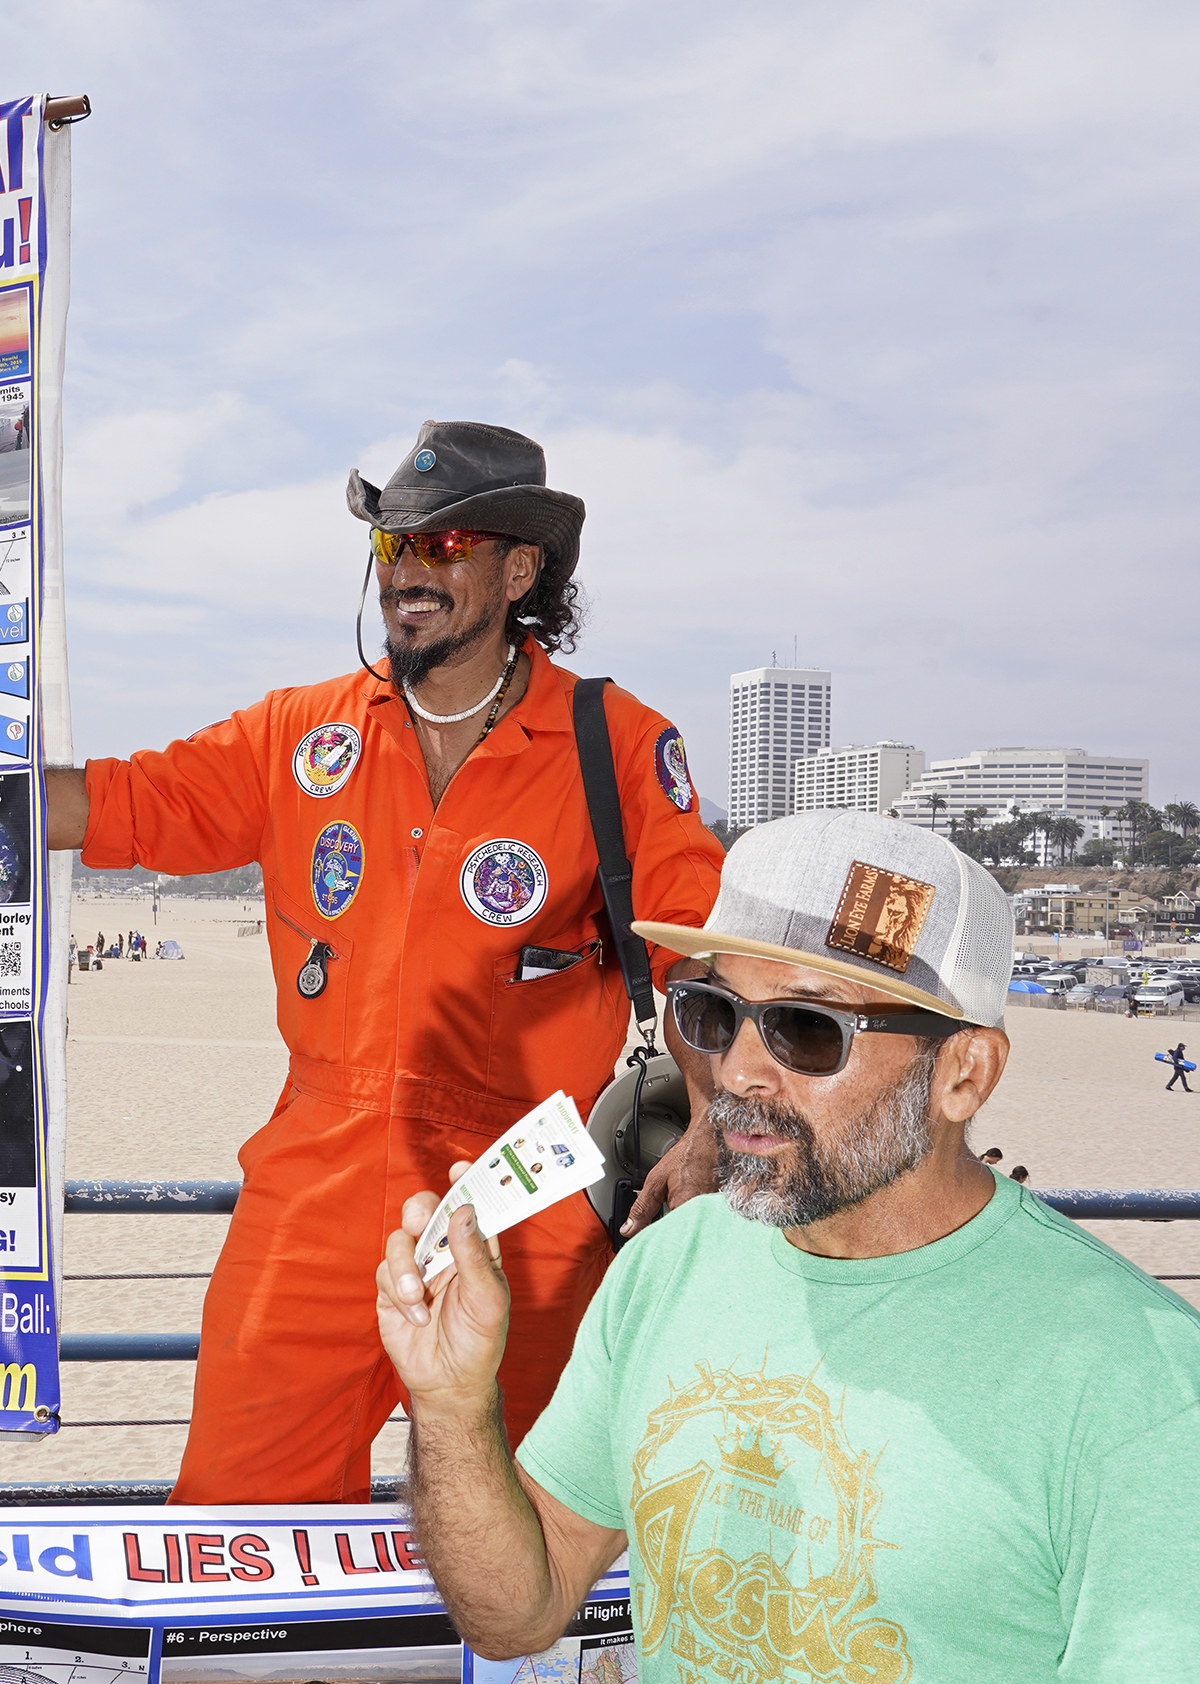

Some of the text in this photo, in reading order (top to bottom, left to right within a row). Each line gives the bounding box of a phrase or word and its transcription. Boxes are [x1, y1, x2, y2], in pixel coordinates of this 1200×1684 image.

[1, 392, 24, 403] 1945
[299, 727, 339, 756] PSYCHEDELIC
[310, 784, 333, 793] CREW
[326, 825, 338, 835] JOHN
[320, 837, 359, 854] DISCOVERY
[467, 843, 544, 886] PSYCHEDELIC RESEARCH
[481, 909, 513, 922] CREW
[840, 870, 879, 946] LION EYE FARMS
[2, 1292, 50, 1335] Ball:
[707, 1482, 832, 1546] AT THE NAME OF
[123, 1532, 275, 1583] LIES
[293, 1529, 320, 1586] !
[334, 1531, 426, 1575] LIE
[630, 1459, 913, 1684] Jesus
[585, 1605, 624, 1621] Flight
[166, 1627, 288, 1644] #6 Perspective
[601, 1636, 605, 1645] It
[606, 1635, 628, 1644] makes
